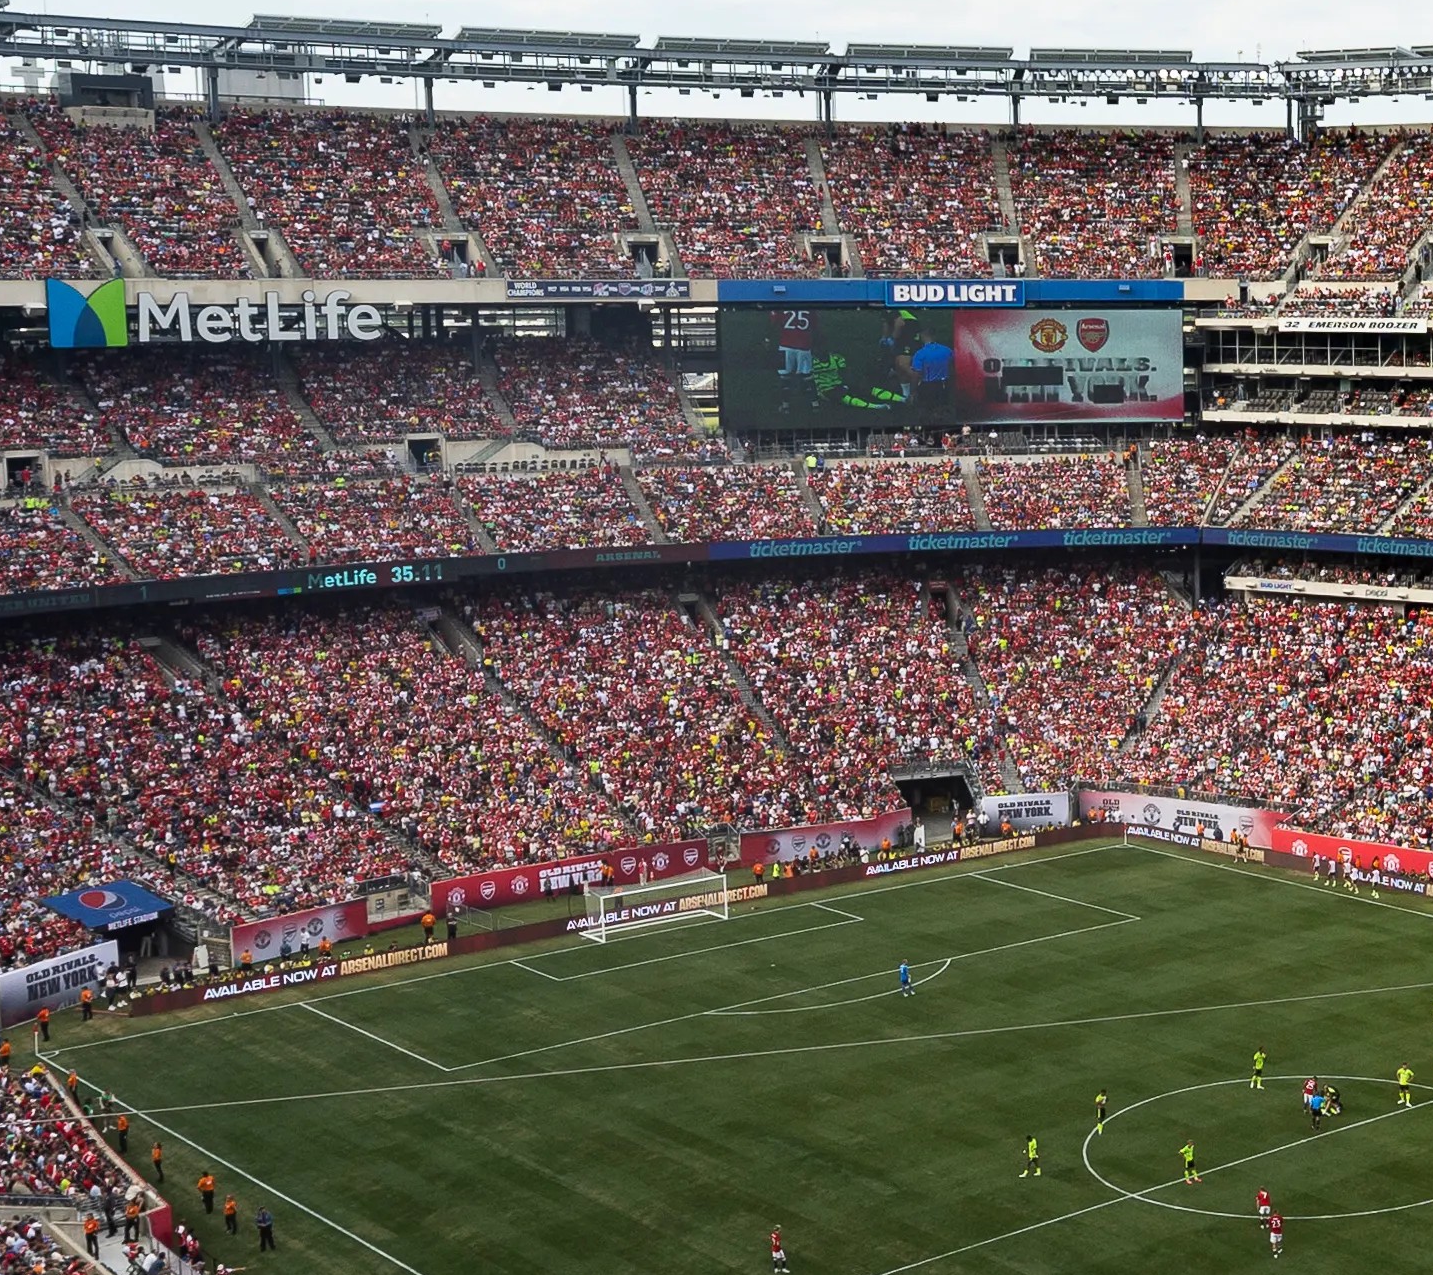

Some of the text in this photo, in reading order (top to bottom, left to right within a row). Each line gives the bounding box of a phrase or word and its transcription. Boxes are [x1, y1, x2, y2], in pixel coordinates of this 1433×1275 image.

[894, 286, 1016, 302] BUD LIGHT
[139, 289, 384, 343] MetLife
[783, 311, 810, 331] 25
[1284, 321, 1418, 330] 32 EMERSON BOOZER
[497, 557, 506, 570] 0
[307, 569, 377, 589] MetLife
[140, 585, 147, 600] 1
[998, 801, 1017, 809] OLD
[1127, 825, 1170, 844] AVAILABLE
[866, 835, 1037, 875] AVAILABLE NOW AT ARSENALDIRECT.COM
[1390, 877, 1413, 890] NOW
[1414, 883, 1426, 894] AT
[107, 911, 159, 932] METLIFE STADIUM
[566, 900, 677, 931] AVAILABLE NOW AT
[26, 954, 99, 984] OLD RIVALS.
[203, 941, 449, 1001] AVAILABLE NOW AT ARSENALDIRECT.COM
[26, 975, 61, 1002] NEW
